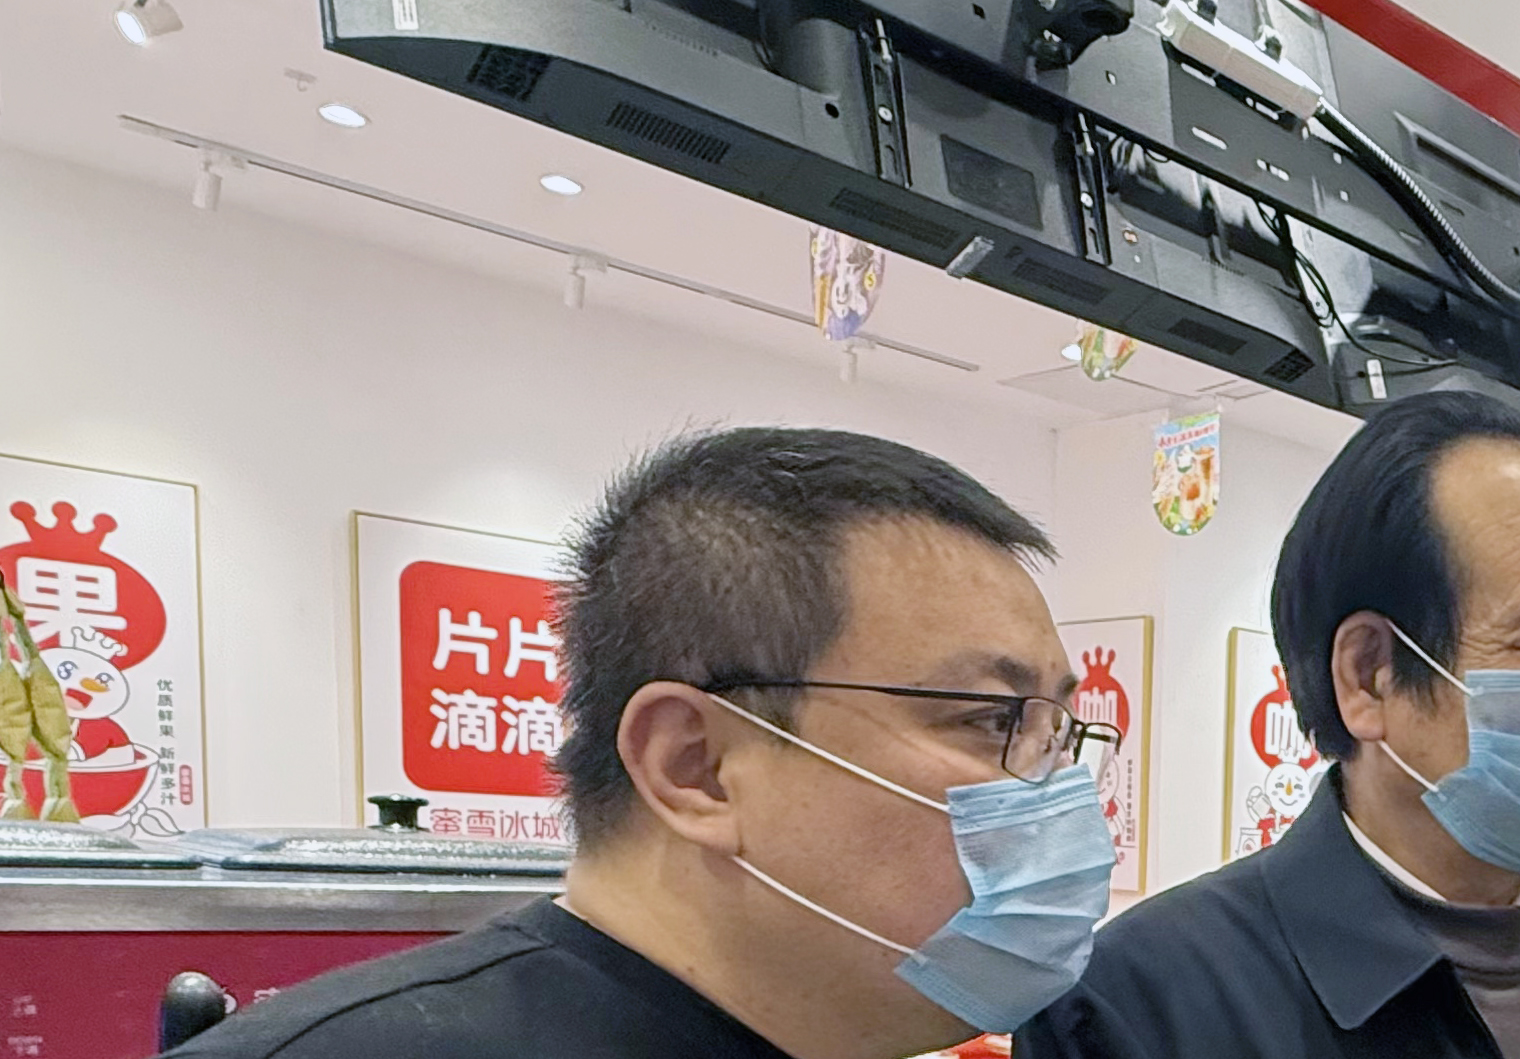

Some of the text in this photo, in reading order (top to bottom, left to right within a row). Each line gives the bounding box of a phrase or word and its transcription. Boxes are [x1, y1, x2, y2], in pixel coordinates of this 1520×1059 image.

[16, 556, 128, 648] 果
[432, 607, 565, 682] 片片
[157, 679, 177, 805] 优质鲜果 新鲜多汁
[429, 688, 565, 756] 滴滴
[430, 807, 562, 840] 蜜雪冰城
